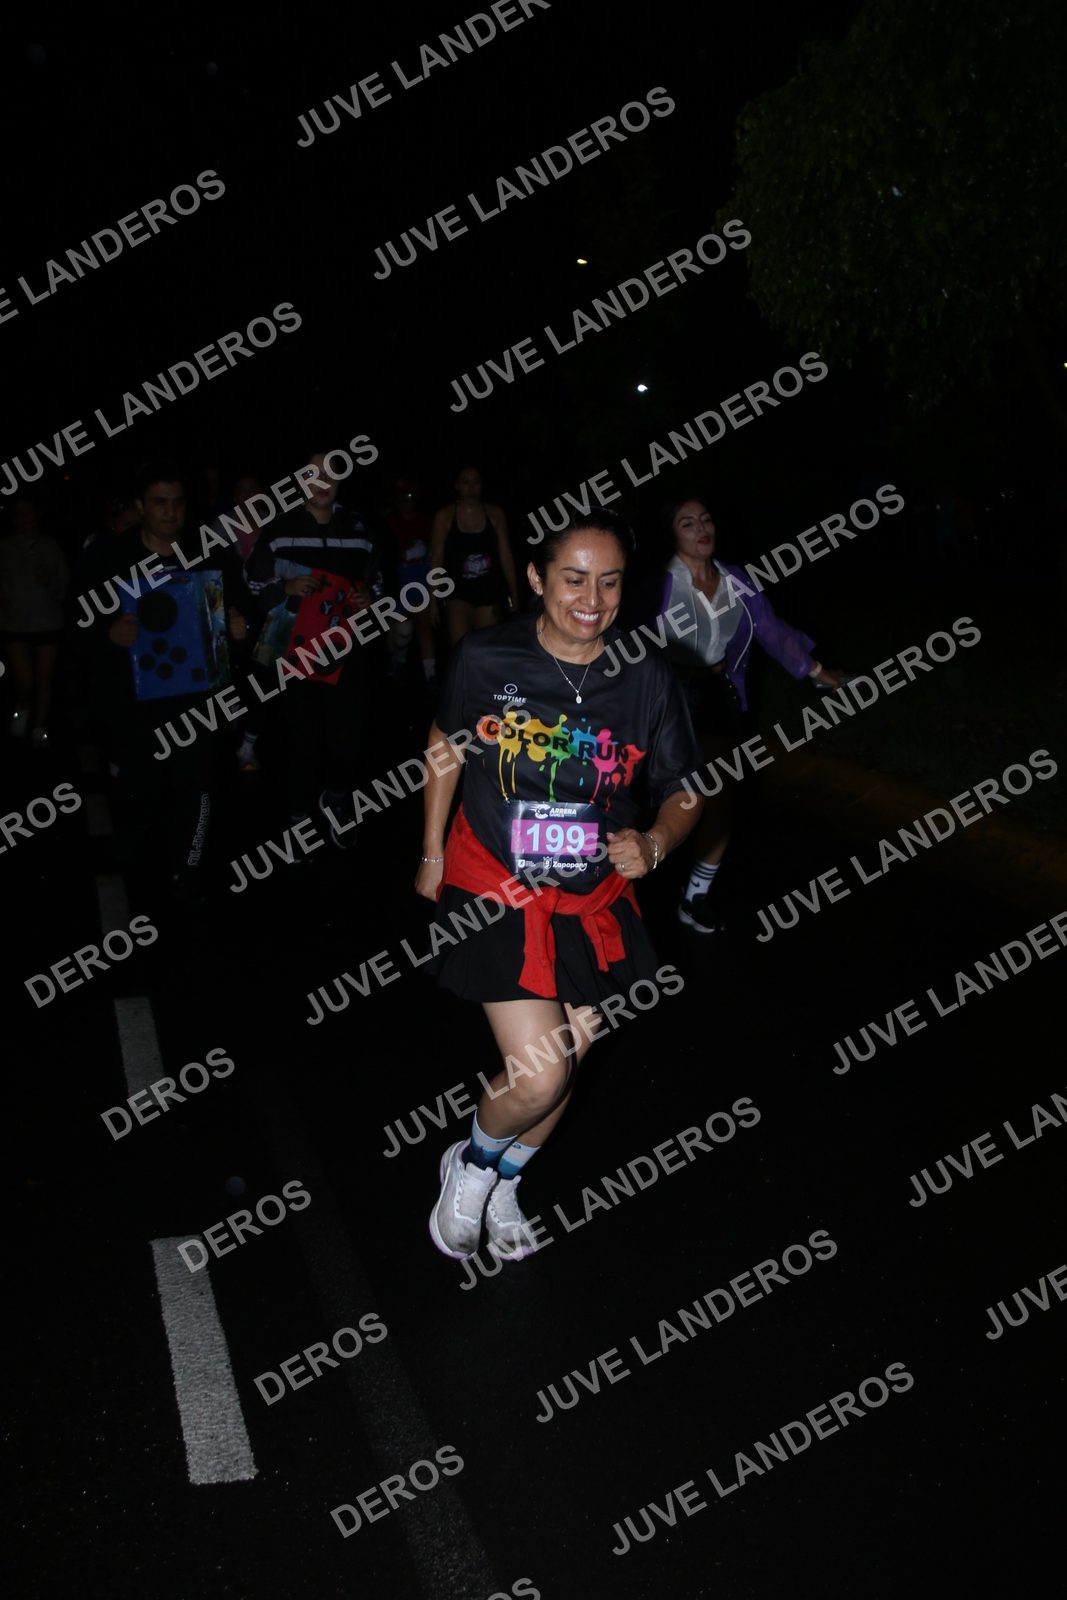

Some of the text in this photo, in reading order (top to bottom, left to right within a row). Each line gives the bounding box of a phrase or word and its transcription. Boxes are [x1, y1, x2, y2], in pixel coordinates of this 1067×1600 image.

[493, 694, 527, 704] TOPTIME
[487, 720, 629, 763] COLOR RUN
[526, 823, 585, 853] 199
